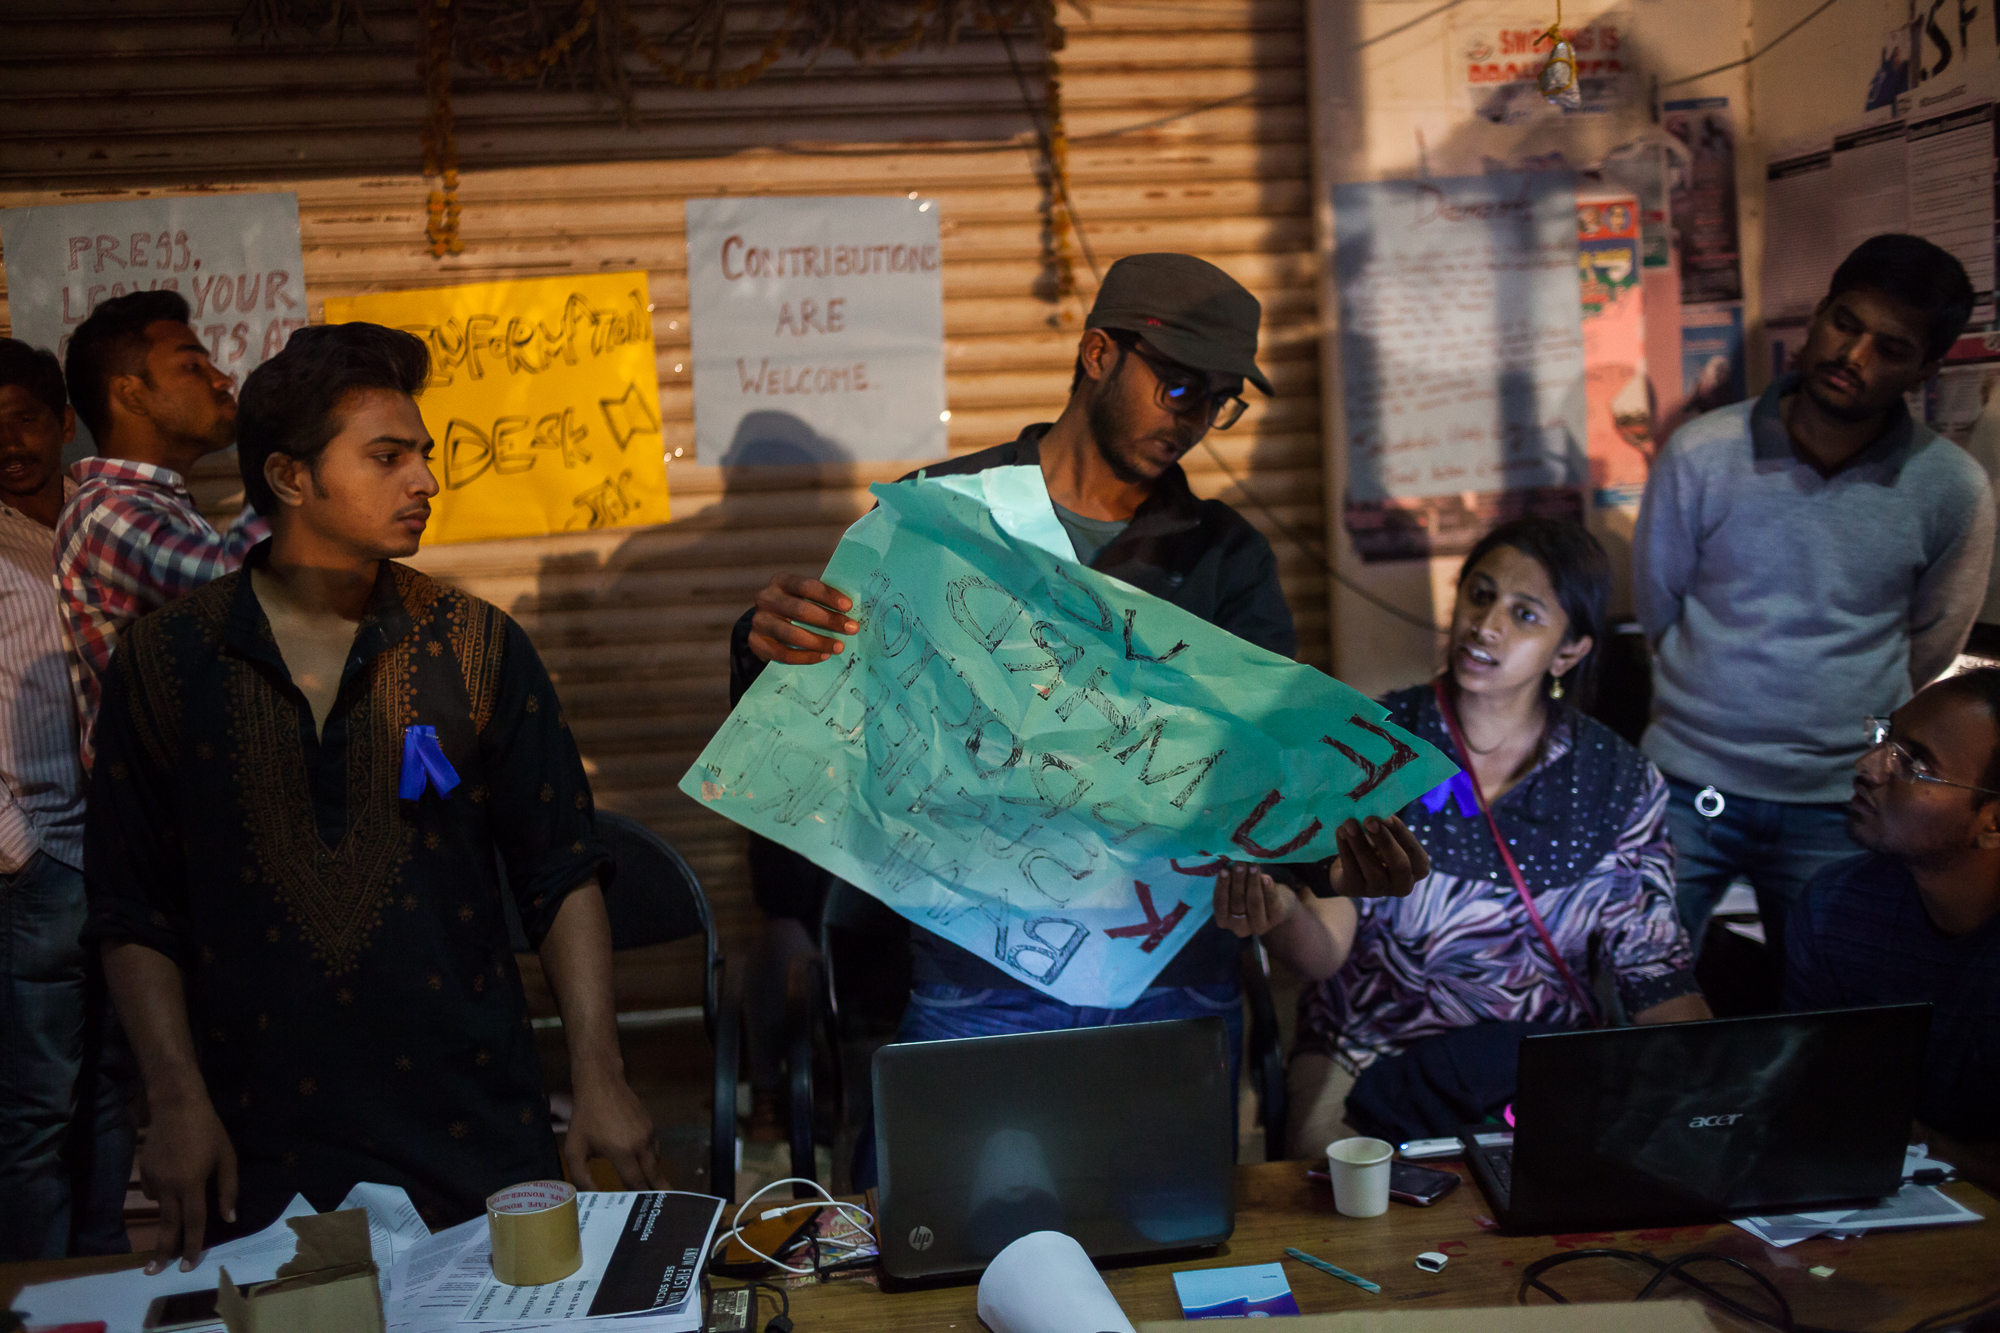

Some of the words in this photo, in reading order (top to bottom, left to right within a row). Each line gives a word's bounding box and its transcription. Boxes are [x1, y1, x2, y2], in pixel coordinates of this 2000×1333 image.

[68, 229, 201, 273] PRESS,
[195, 270, 297, 320] YOUR
[775, 298, 846, 336] ARE
[444, 407, 594, 491] DESK
[1689, 1113, 1743, 1129] acer
[910, 1226, 933, 1251] hp
[681, 1247, 700, 1266] KNOW
[662, 1265, 676, 1283] SEEK
[672, 1268, 692, 1289] FIRST
[551, 1281, 564, 1300] called
[577, 1280, 589, 1291] How
[571, 1292, 581, 1303] can
